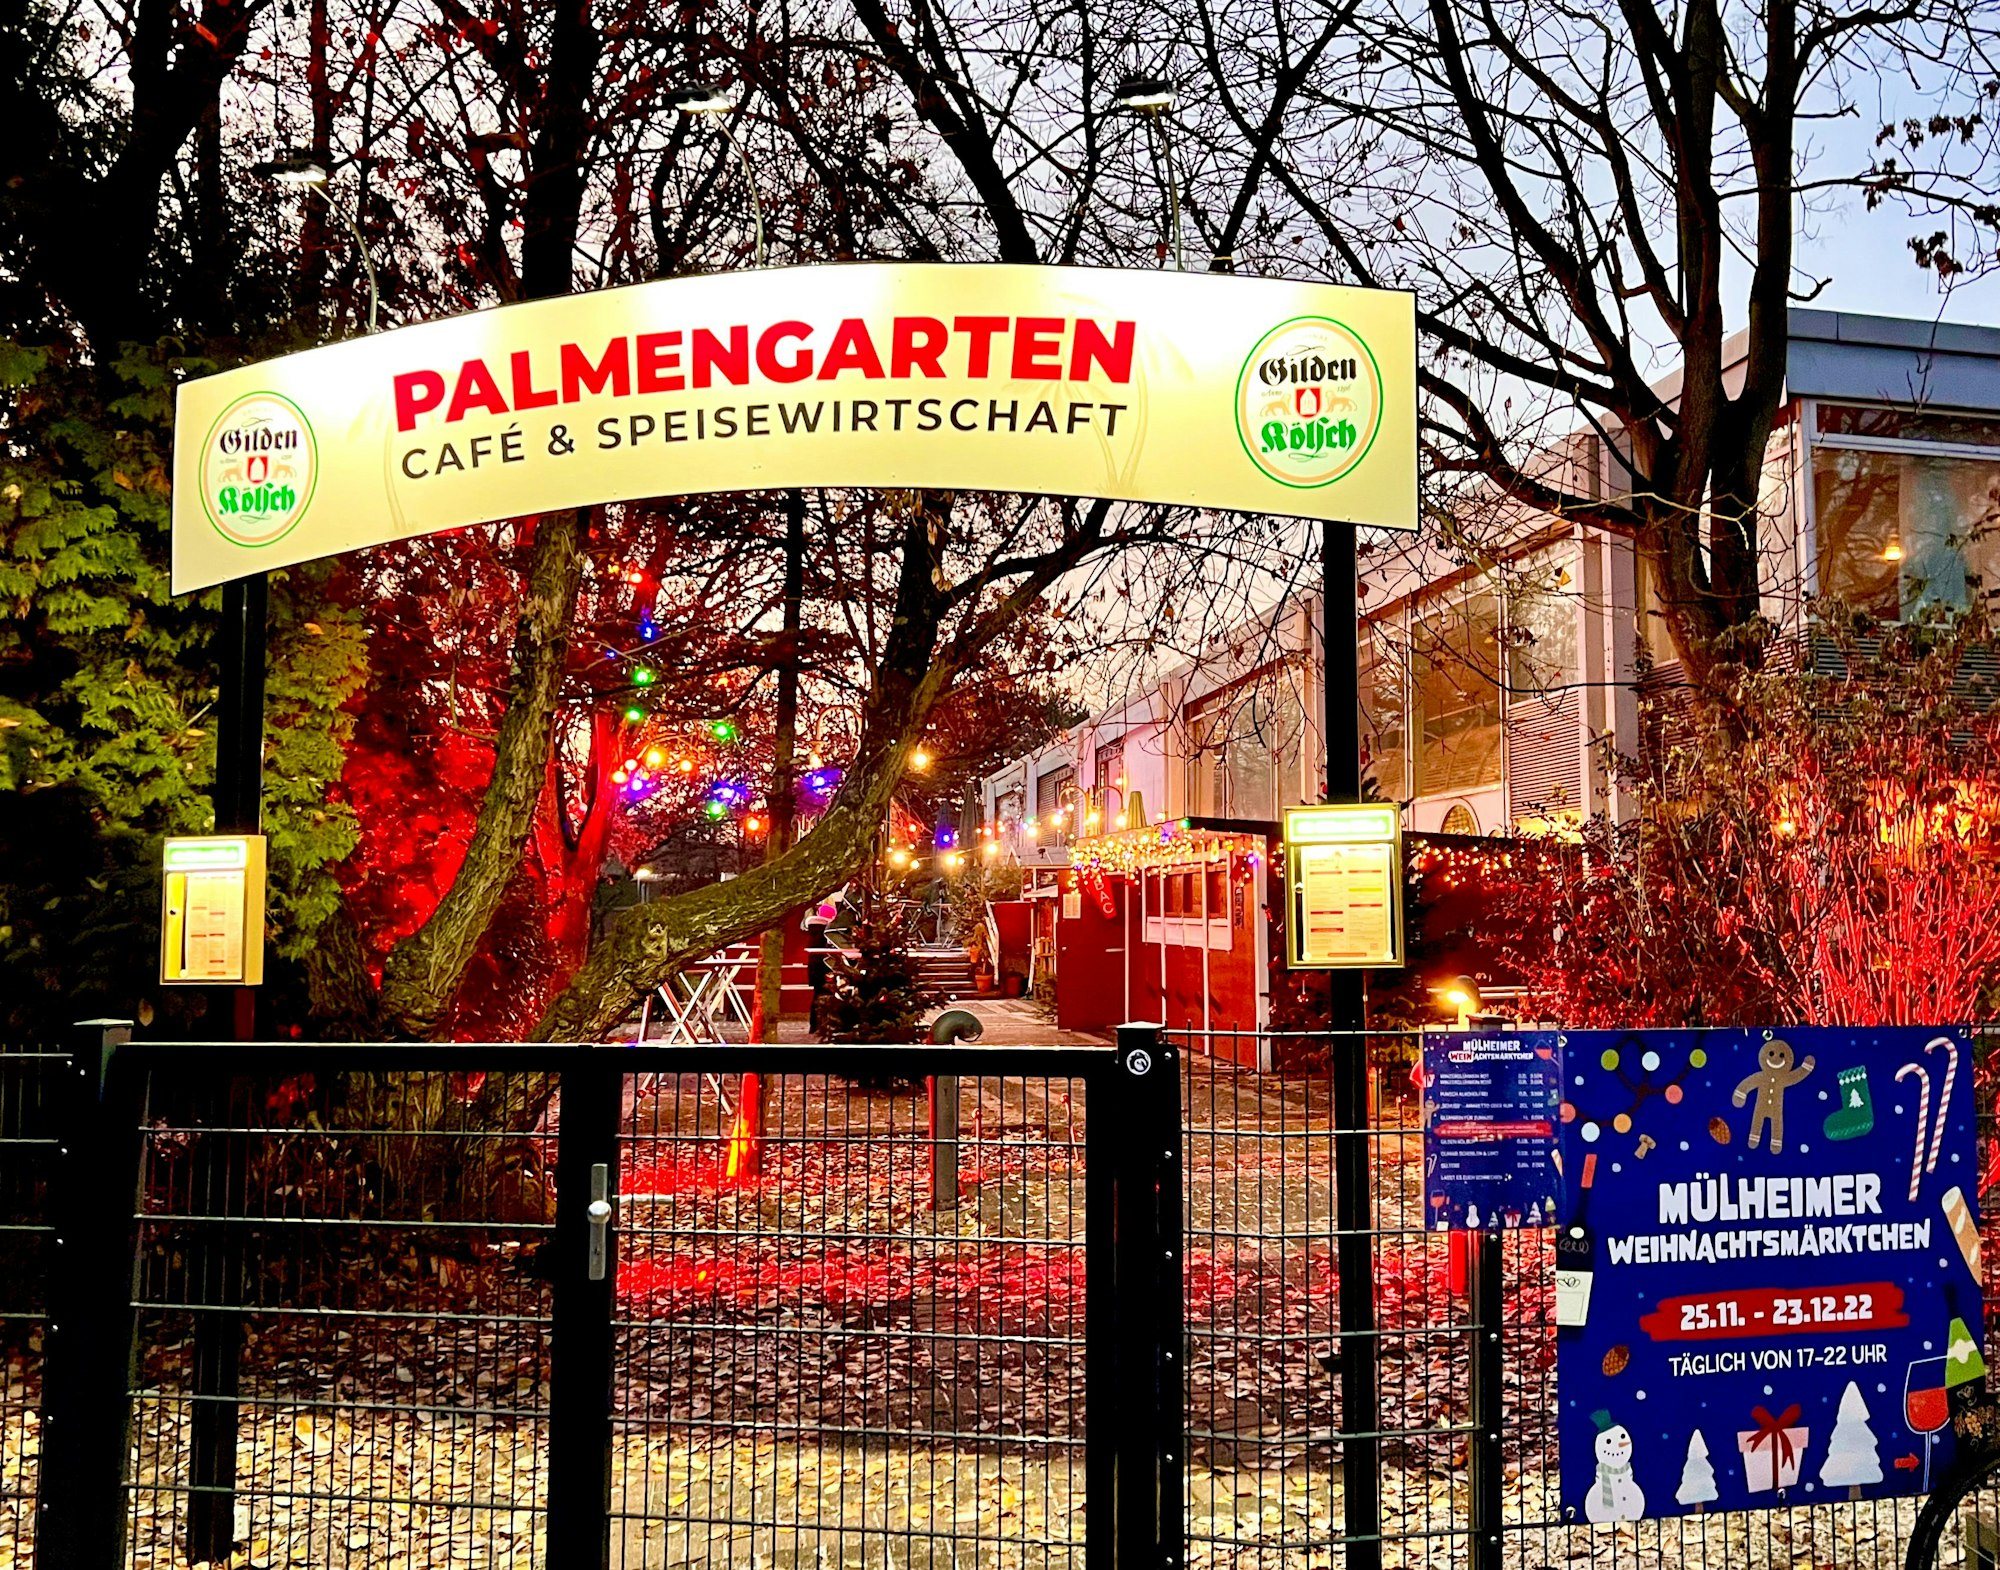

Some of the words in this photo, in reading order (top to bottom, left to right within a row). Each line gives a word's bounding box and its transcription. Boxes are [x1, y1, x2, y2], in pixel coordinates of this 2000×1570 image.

[393, 316, 1136, 432] PALMENGARTEN
[1259, 355, 1357, 387] Gilden
[219, 427, 298, 456] Gilden
[401, 422, 525, 479] CAFÉ
[547, 424, 575, 455] &
[597, 398, 1128, 449] SPEISEWIRTSCHAFT
[1658, 1172, 1882, 1224] MÜLHEIMER
[1608, 1218, 1931, 1264] WEIHNACHTSMÄRKTCHEN
[1680, 1301, 1745, 1331] 25.11.
[1753, 1310, 1764, 1319] -
[1772, 1294, 1873, 1325] 23.12.22
[1668, 1352, 1746, 1377] TÄGLICH
[1751, 1349, 1792, 1371] VON
[1796, 1346, 1848, 1367] 17-22
[1852, 1344, 1887, 1364] UHR
